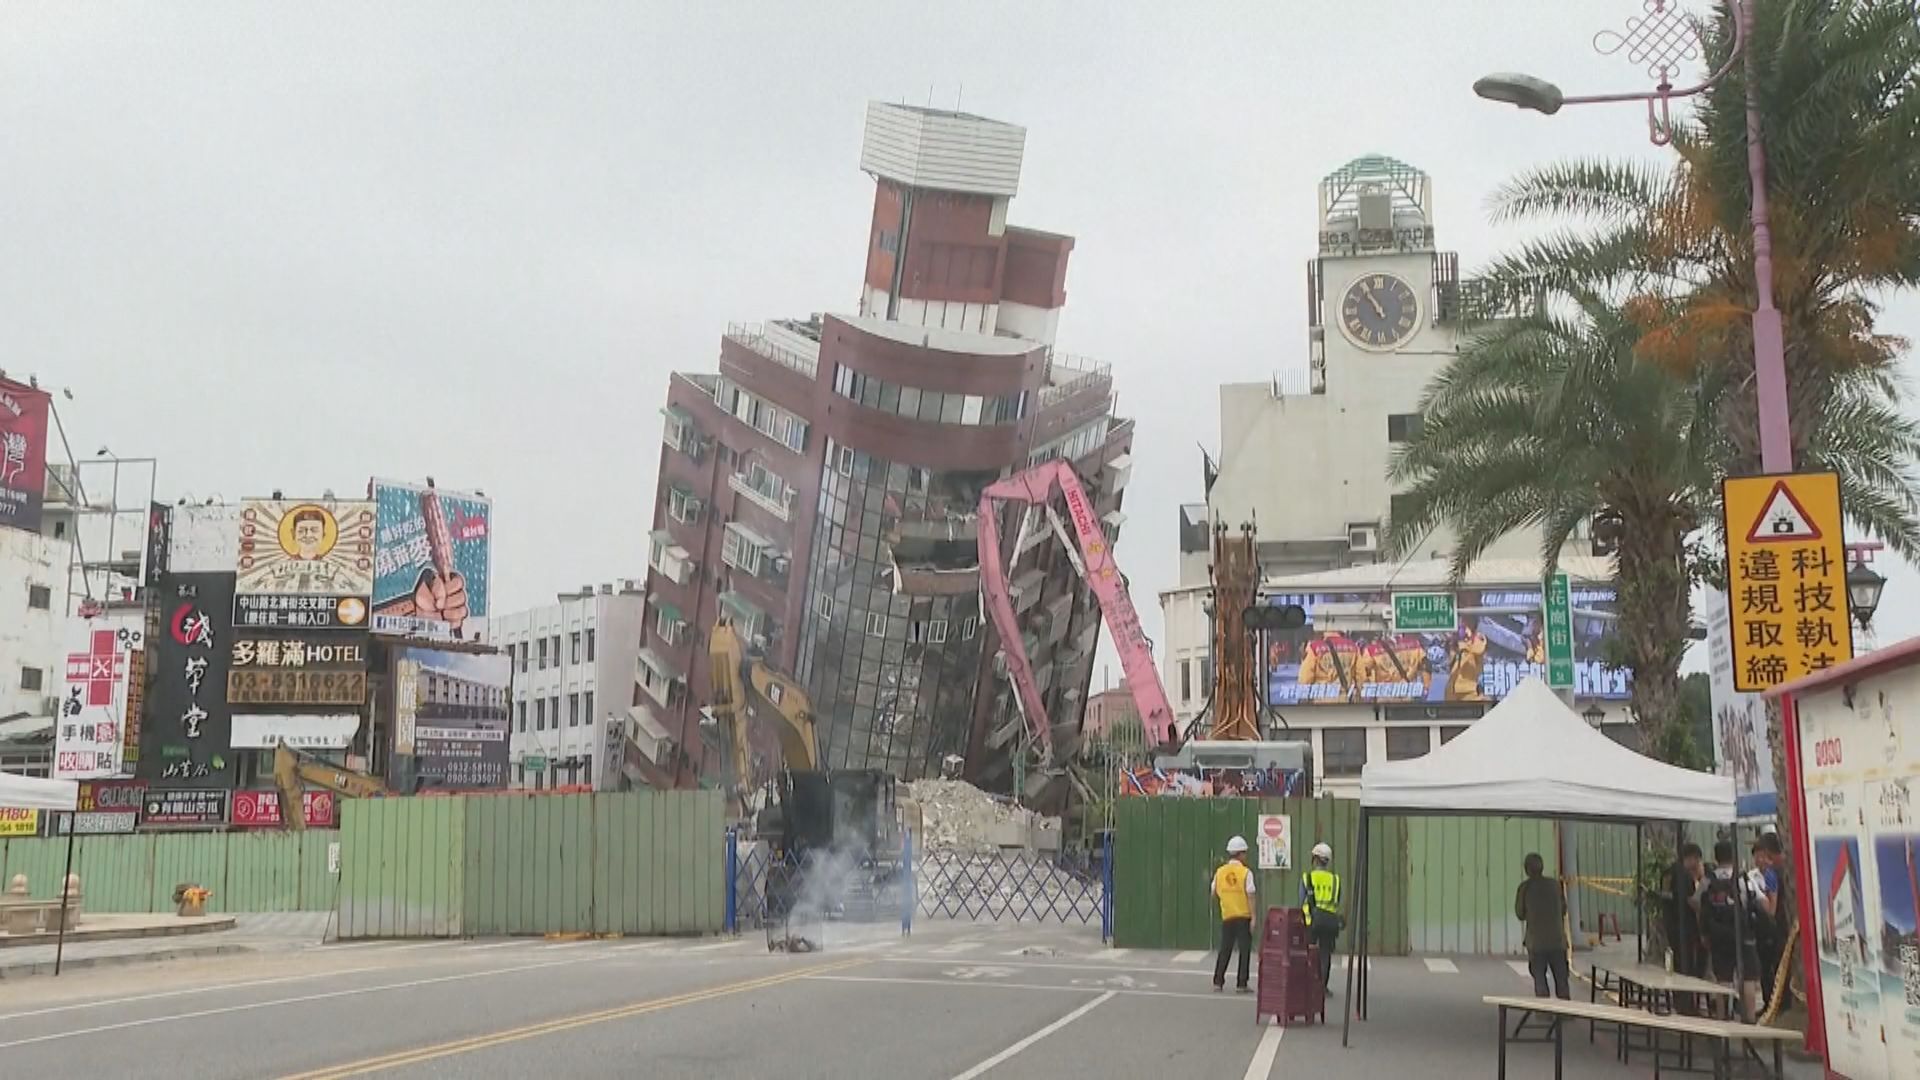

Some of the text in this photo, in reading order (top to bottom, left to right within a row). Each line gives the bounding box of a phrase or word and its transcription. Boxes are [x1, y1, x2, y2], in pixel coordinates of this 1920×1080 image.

[1068, 489, 1092, 536] HITACHI
[1401, 597, 1448, 612] 中山路
[1550, 588, 1567, 646] 花崗街
[1739, 550, 1788, 686] 違規取締
[1792, 547, 1838, 676] 科技執法
